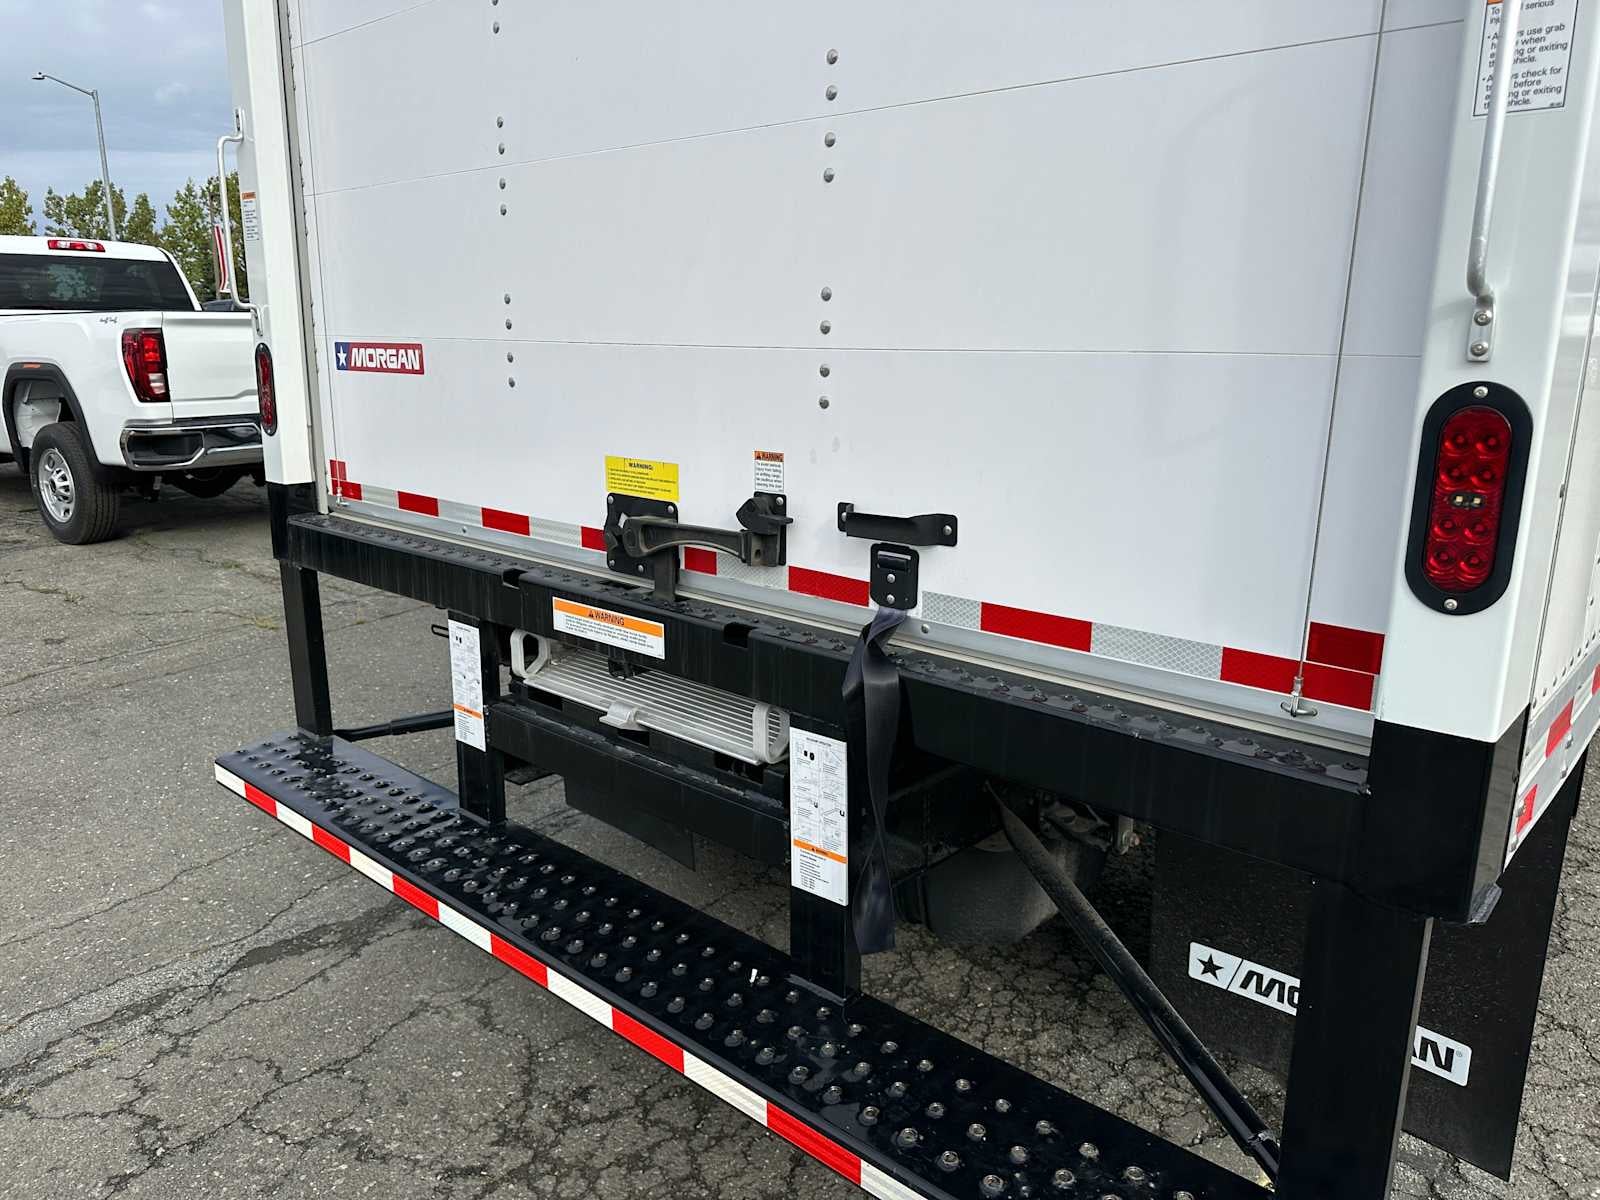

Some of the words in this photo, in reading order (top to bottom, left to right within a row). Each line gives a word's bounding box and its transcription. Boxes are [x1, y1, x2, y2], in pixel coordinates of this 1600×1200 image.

[1491, 6, 1501, 15] To
[1526, 26, 1542, 36] use
[1545, 22, 1566, 35] grab
[1520, 35, 1546, 45] when
[1526, 46, 1536, 54] or
[1538, 41, 1568, 53] exiting
[1521, 67, 1548, 79] check
[1549, 66, 1562, 75] for
[1513, 79, 1542, 89] before
[1521, 89, 1531, 97] or
[1532, 85, 1562, 95] exiting
[350, 347, 421, 370] MORGAN
[594, 611, 625, 626] WARNING
